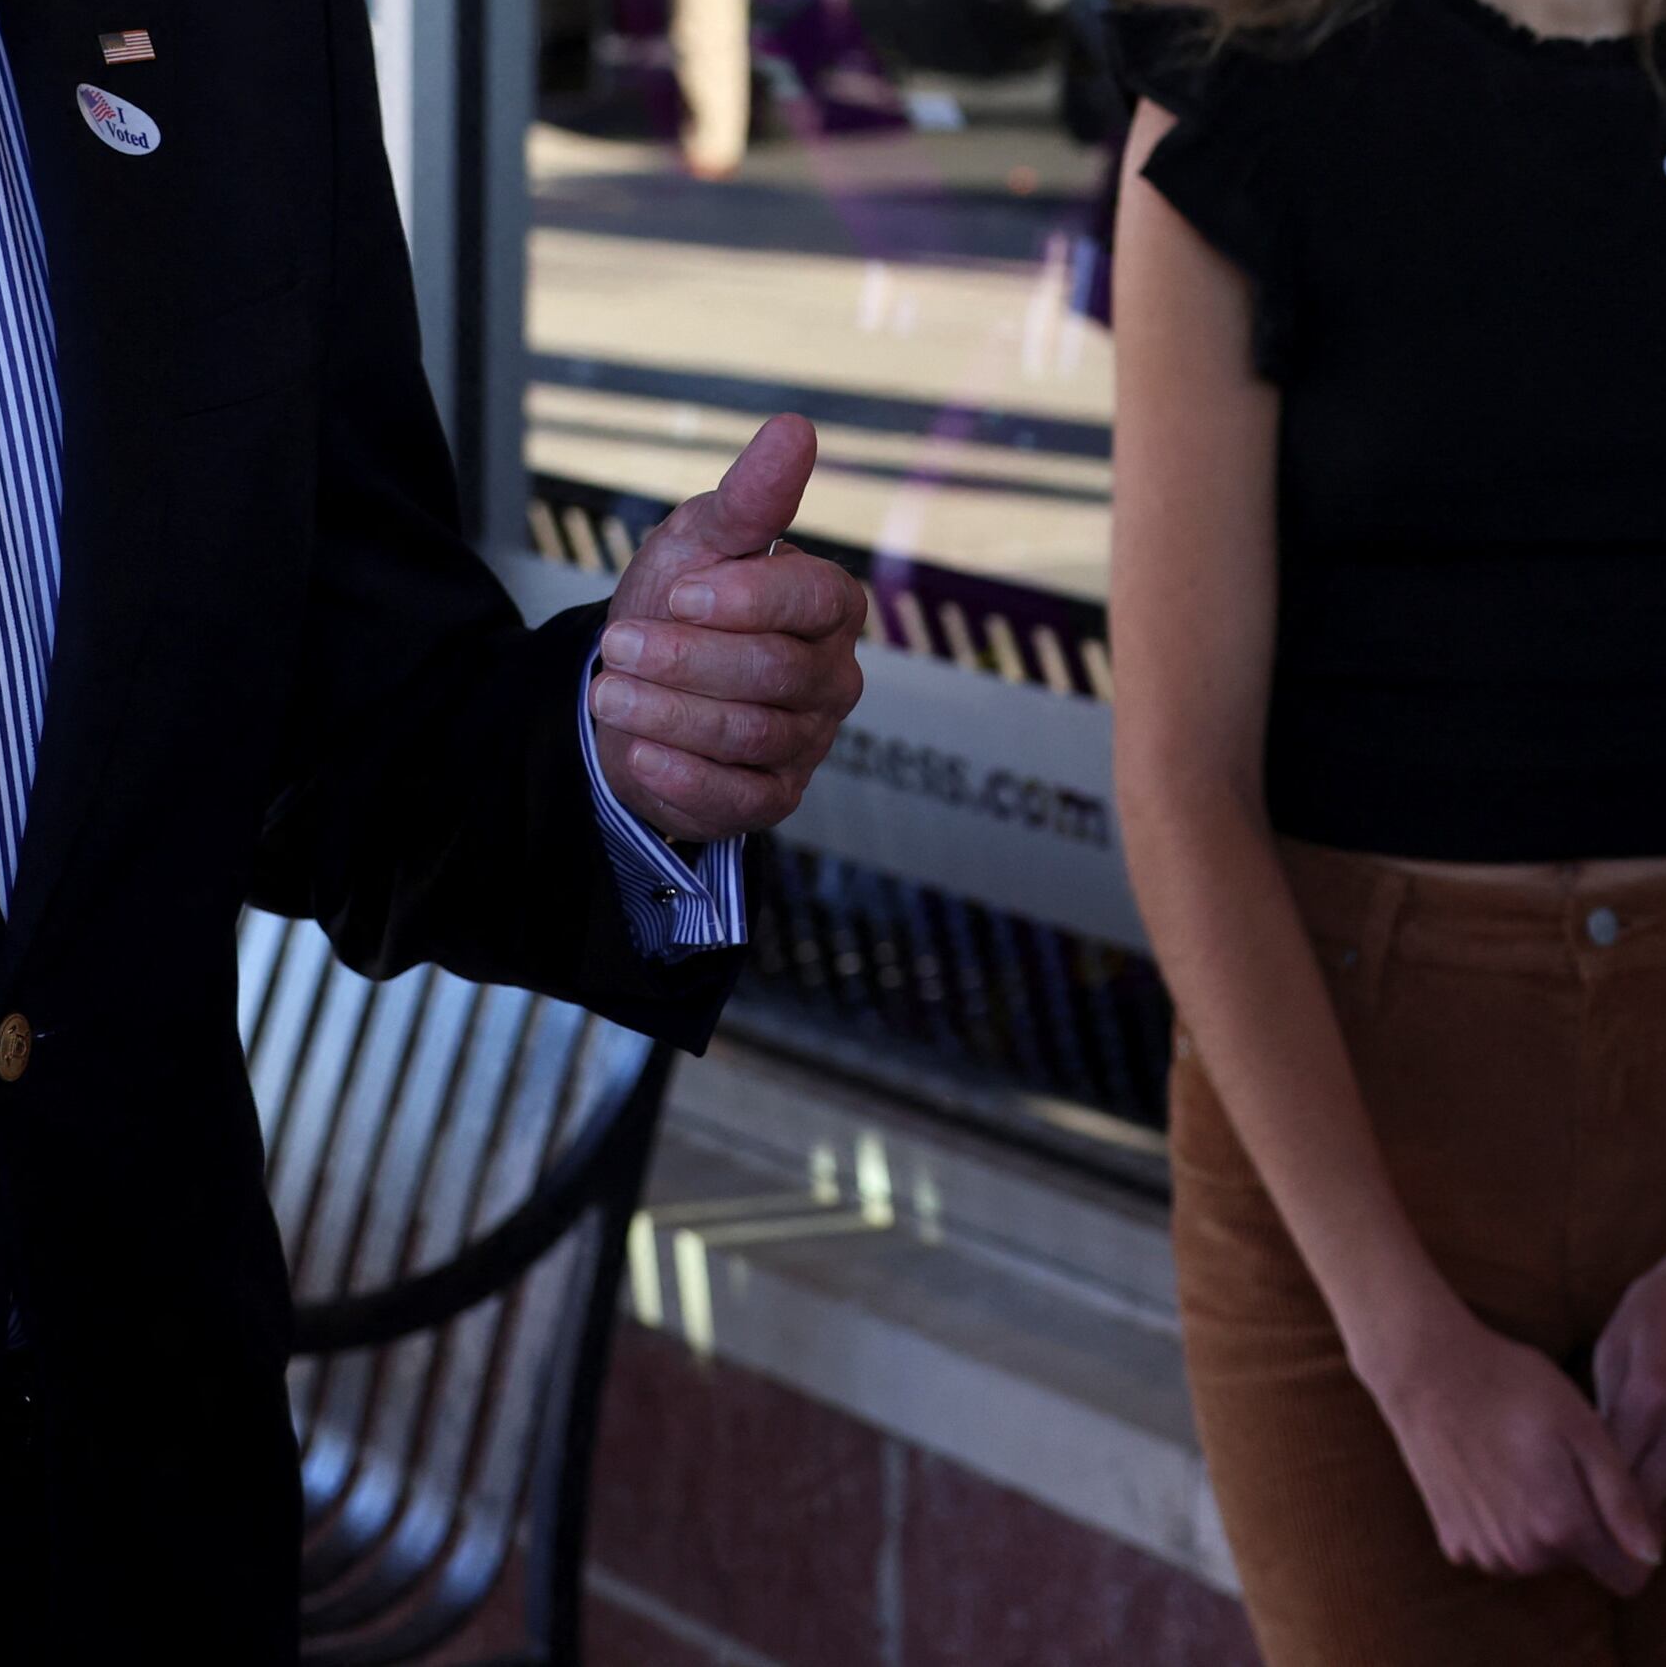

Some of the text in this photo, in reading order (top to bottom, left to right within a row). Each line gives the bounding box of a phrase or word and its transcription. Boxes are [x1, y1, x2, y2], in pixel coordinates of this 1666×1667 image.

[116, 106, 127, 125] I
[104, 119, 151, 150] Voted
[831, 723, 1111, 852] ness.com
